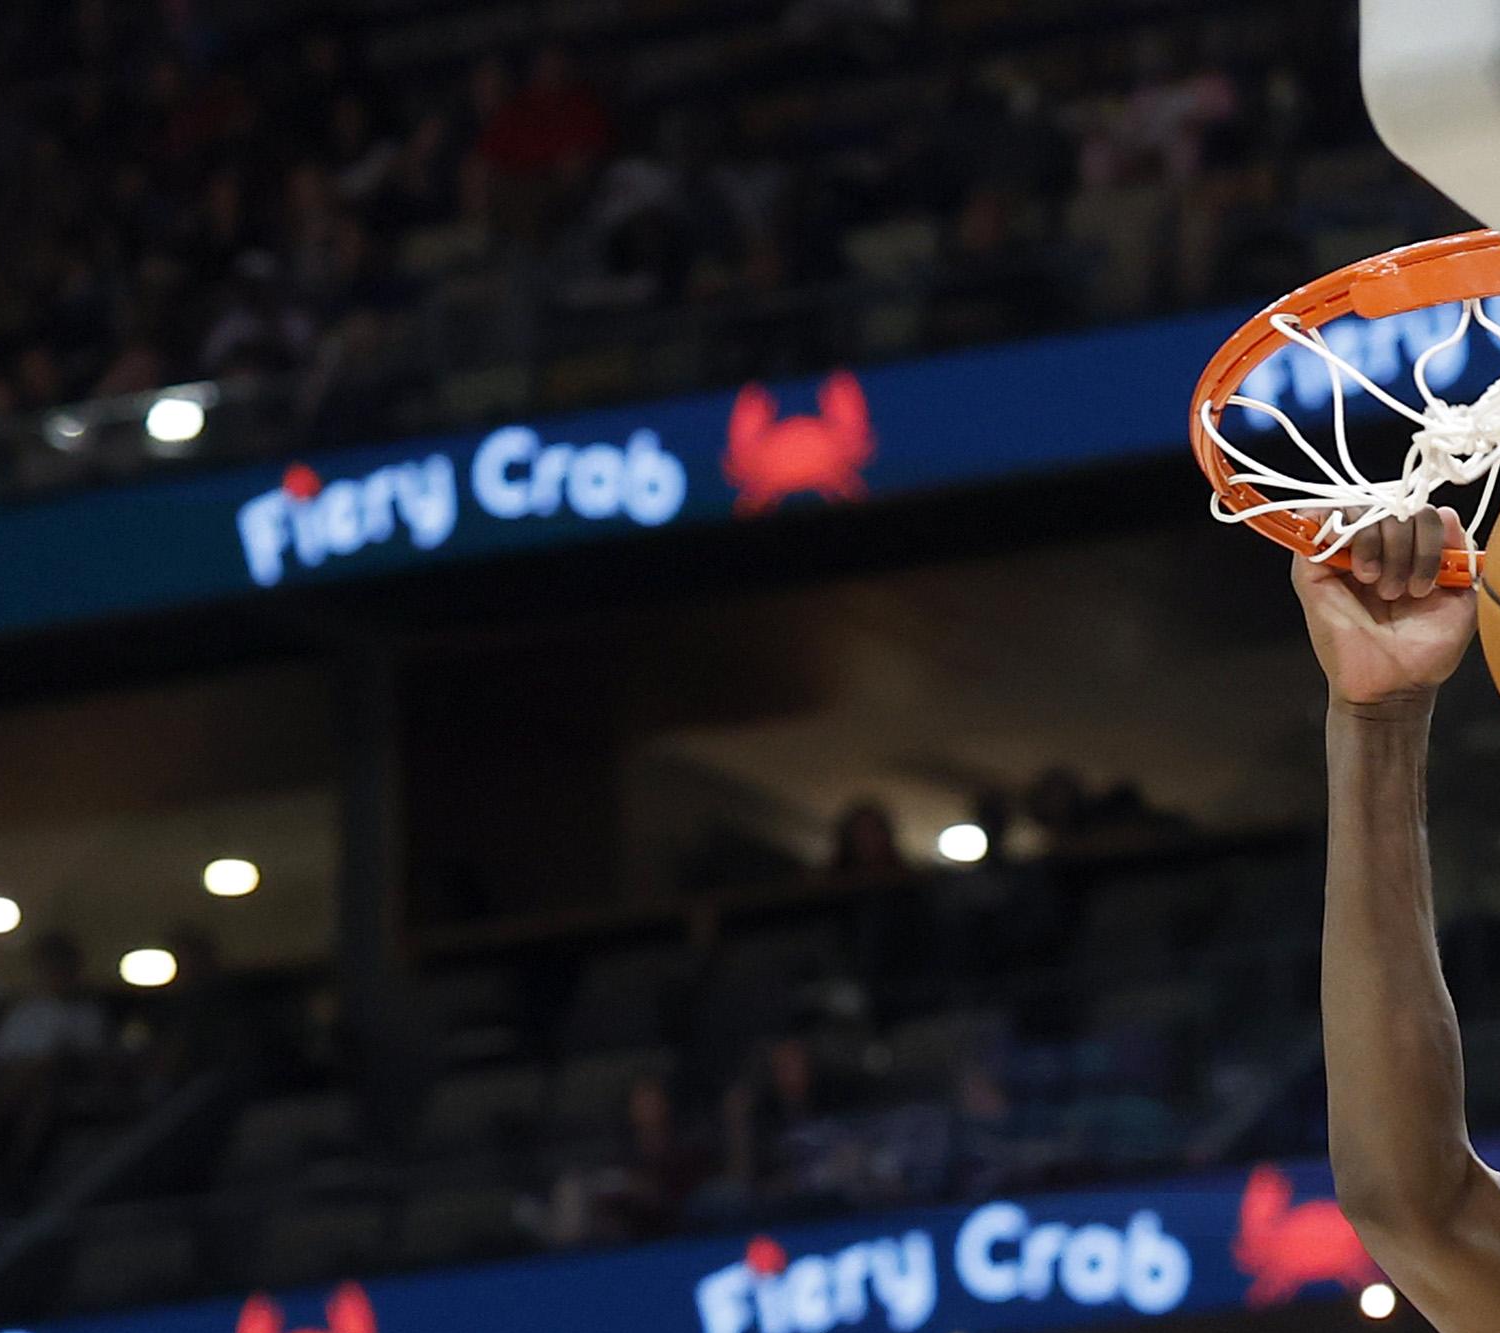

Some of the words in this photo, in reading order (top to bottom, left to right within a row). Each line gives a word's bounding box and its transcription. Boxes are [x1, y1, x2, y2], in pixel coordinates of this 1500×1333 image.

[237, 463, 457, 587] Fiery
[471, 425, 686, 526] Crab
[955, 1202, 1190, 1314] Crab
